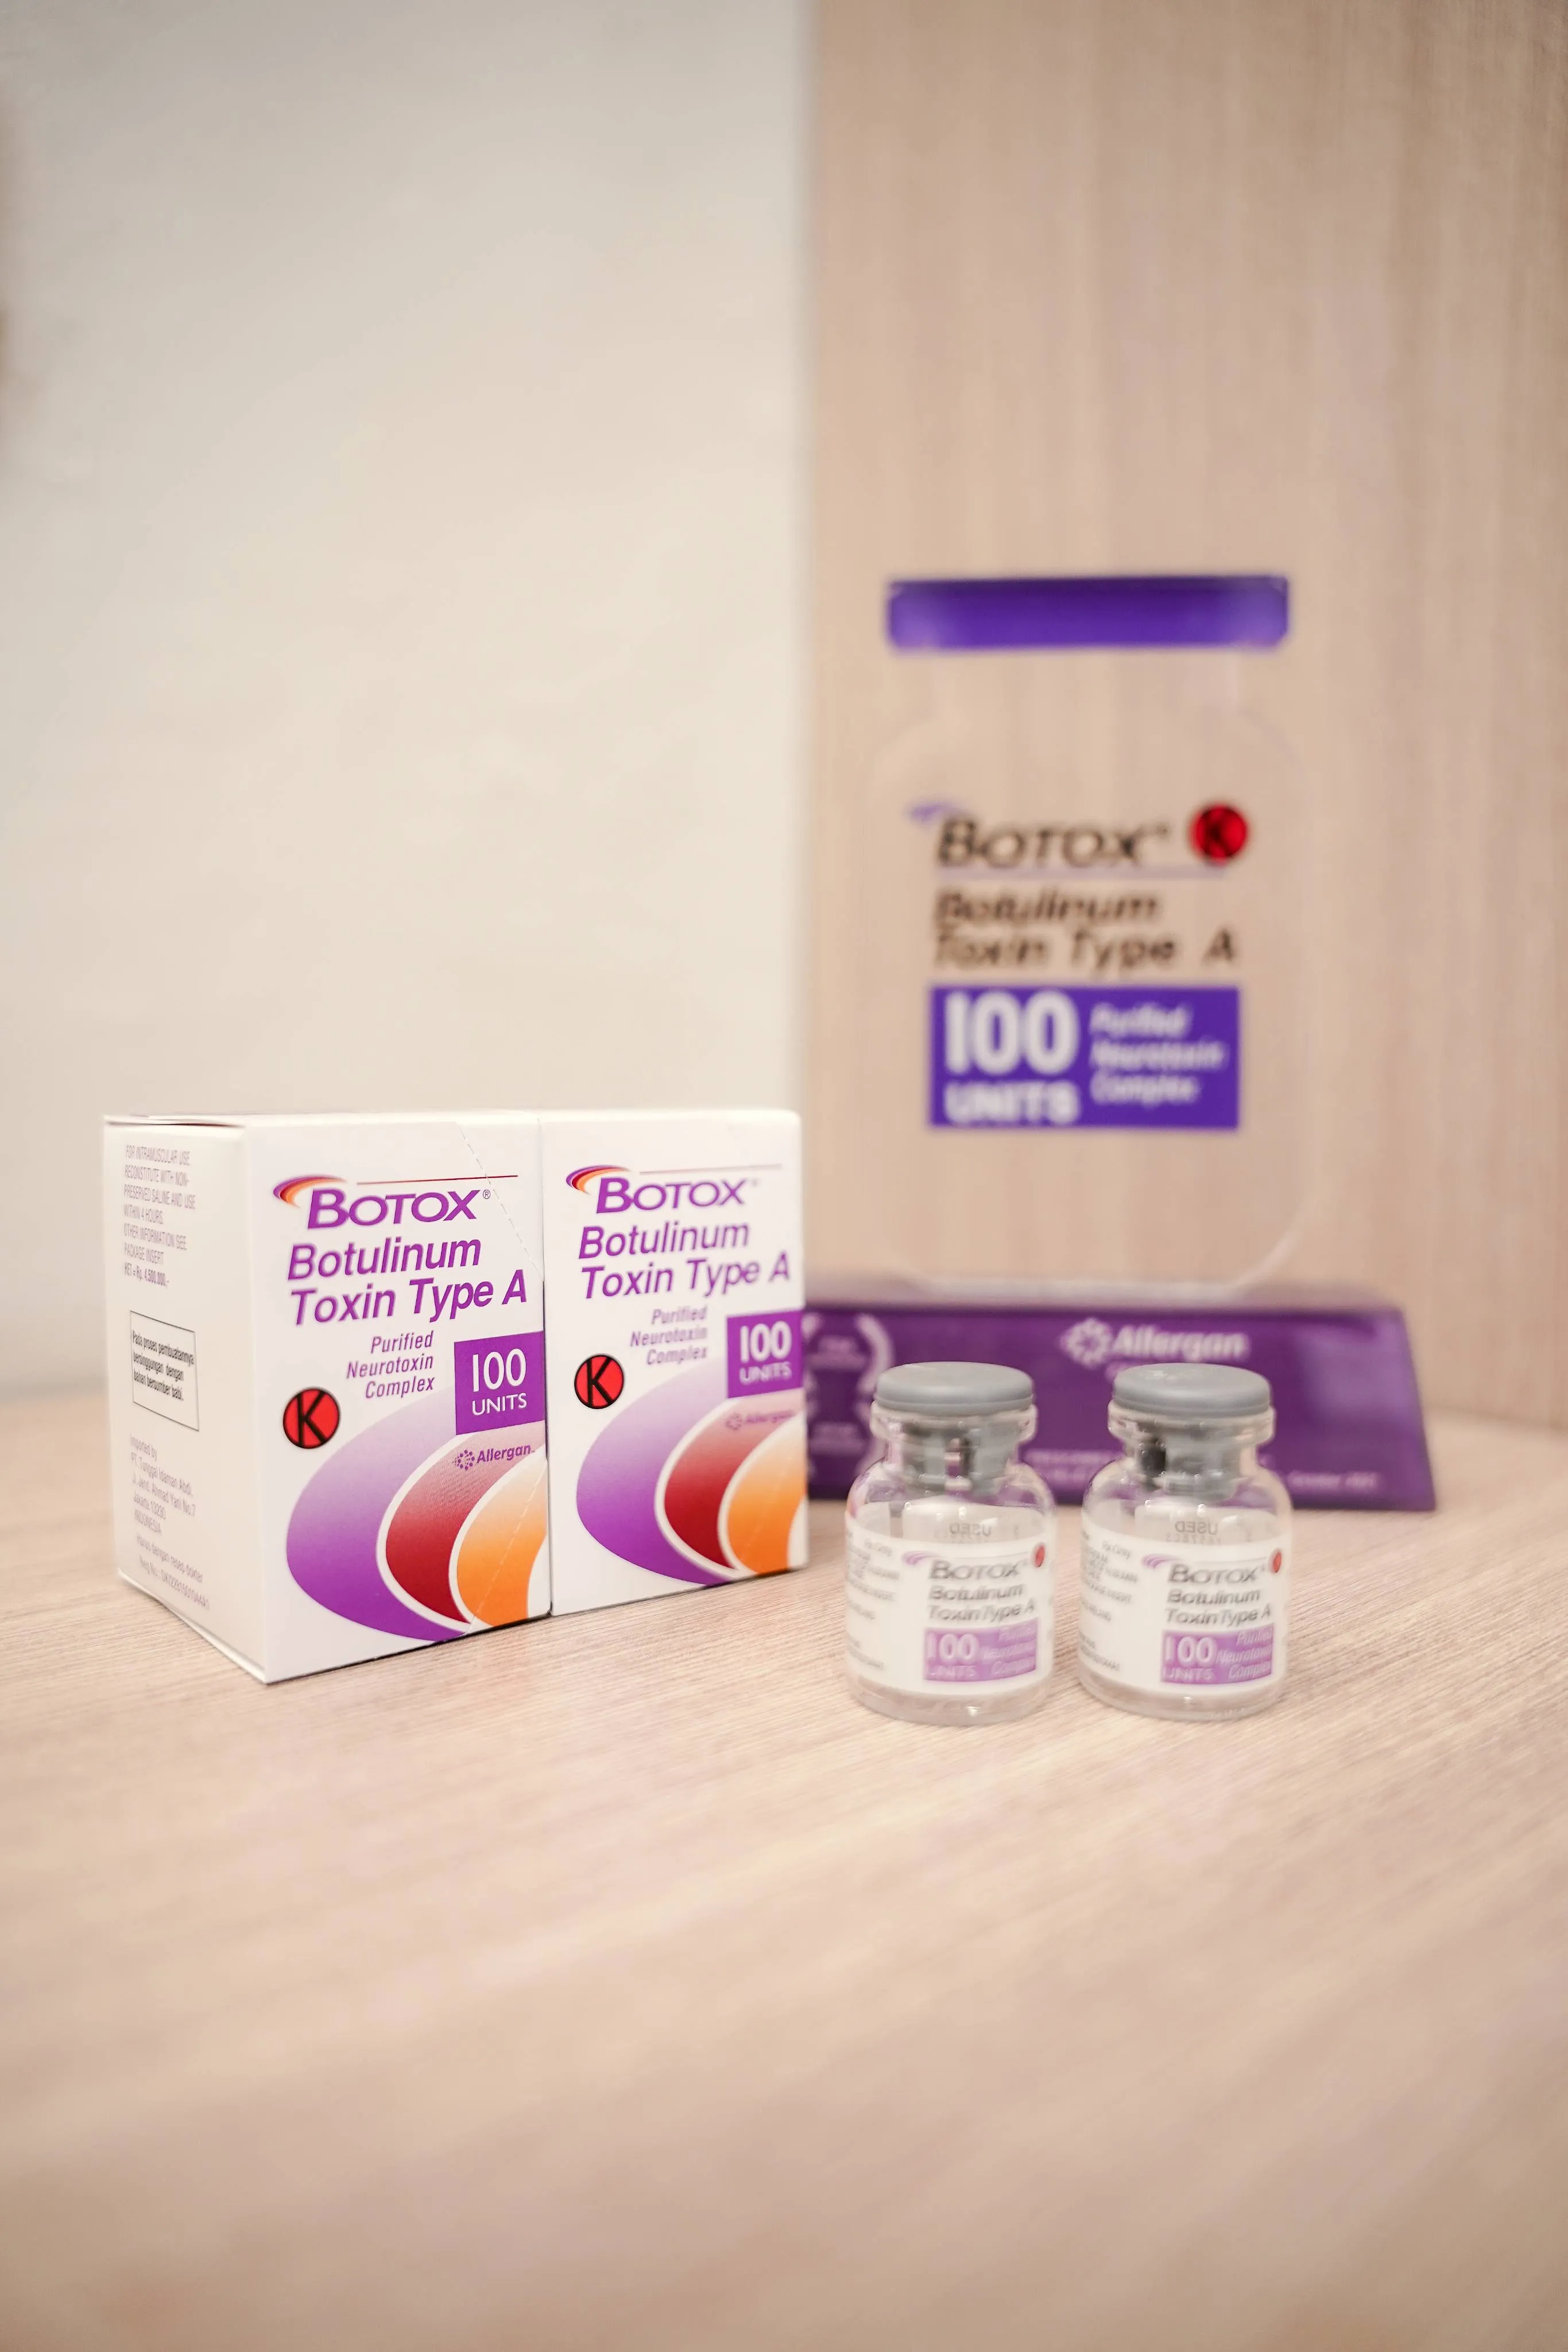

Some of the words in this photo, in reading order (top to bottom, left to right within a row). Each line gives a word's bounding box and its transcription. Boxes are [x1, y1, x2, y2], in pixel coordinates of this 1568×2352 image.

[1203, 926, 1236, 963] A
[944, 989, 1081, 1075] 100
[578, 1220, 750, 1259] Botulinum
[288, 1236, 482, 1281] Botulinum
[581, 1262, 674, 1299] Toxin
[687, 1258, 761, 1298] Type
[768, 1250, 790, 1283] A
[291, 1283, 396, 1326] Toxin
[409, 1276, 494, 1323] Type
[501, 1269, 528, 1306] A
[651, 1305, 708, 1326] Purified
[370, 1330, 435, 1355] Purified
[629, 1326, 708, 1348] Neurotoxin
[739, 1320, 793, 1363] 100
[1112, 1324, 1250, 1361] Allergan
[346, 1353, 435, 1379] Neurotoxin
[646, 1345, 708, 1366] Complex
[471, 1348, 527, 1393] 100
[739, 1361, 792, 1385] UNITS
[365, 1375, 436, 1399] Complex
[471, 1392, 528, 1417] UNITS
[476, 1444, 532, 1464] Allergan
[929, 1583, 1025, 1601] Botulinum
[1167, 1588, 1261, 1605] Botulinum
[928, 1604, 979, 1622] Toxin
[980, 1603, 1022, 1623] Type
[1024, 1597, 1036, 1614] A
[1166, 1608, 1218, 1625] Toxin
[1219, 1607, 1258, 1628] Type
[1260, 1603, 1272, 1619] A
[926, 1632, 980, 1664] 100
[1163, 1635, 1218, 1666] 100
